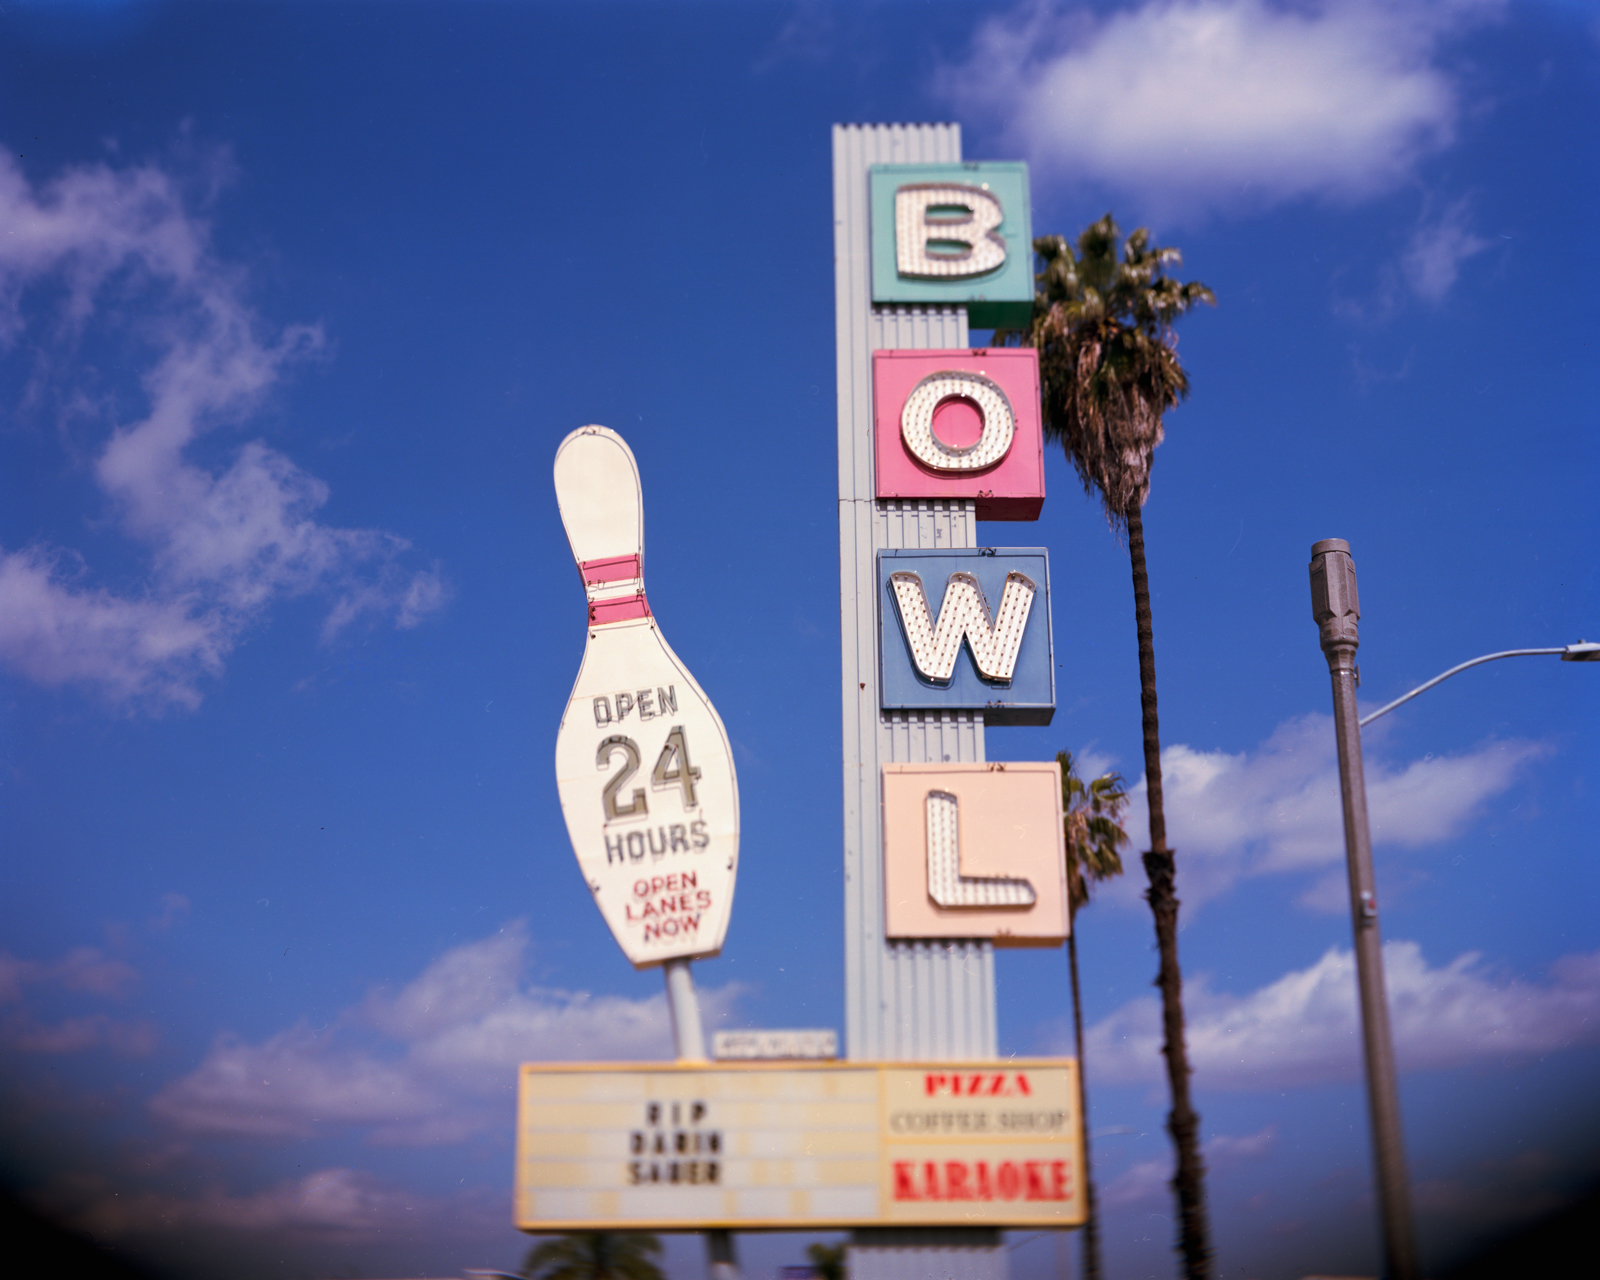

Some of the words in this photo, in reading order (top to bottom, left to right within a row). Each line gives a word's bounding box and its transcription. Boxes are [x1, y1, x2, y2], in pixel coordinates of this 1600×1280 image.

[888, 183, 1036, 907] BOWL
[593, 685, 678, 728] OPEN
[596, 726, 702, 822] 24
[604, 823, 710, 863] HOURS
[634, 871, 697, 897] OPEN
[625, 890, 712, 923] LANES
[644, 916, 700, 942] NOW
[925, 1073, 1031, 1096] PIZZA
[893, 1161, 1073, 1202] KARAOKE
